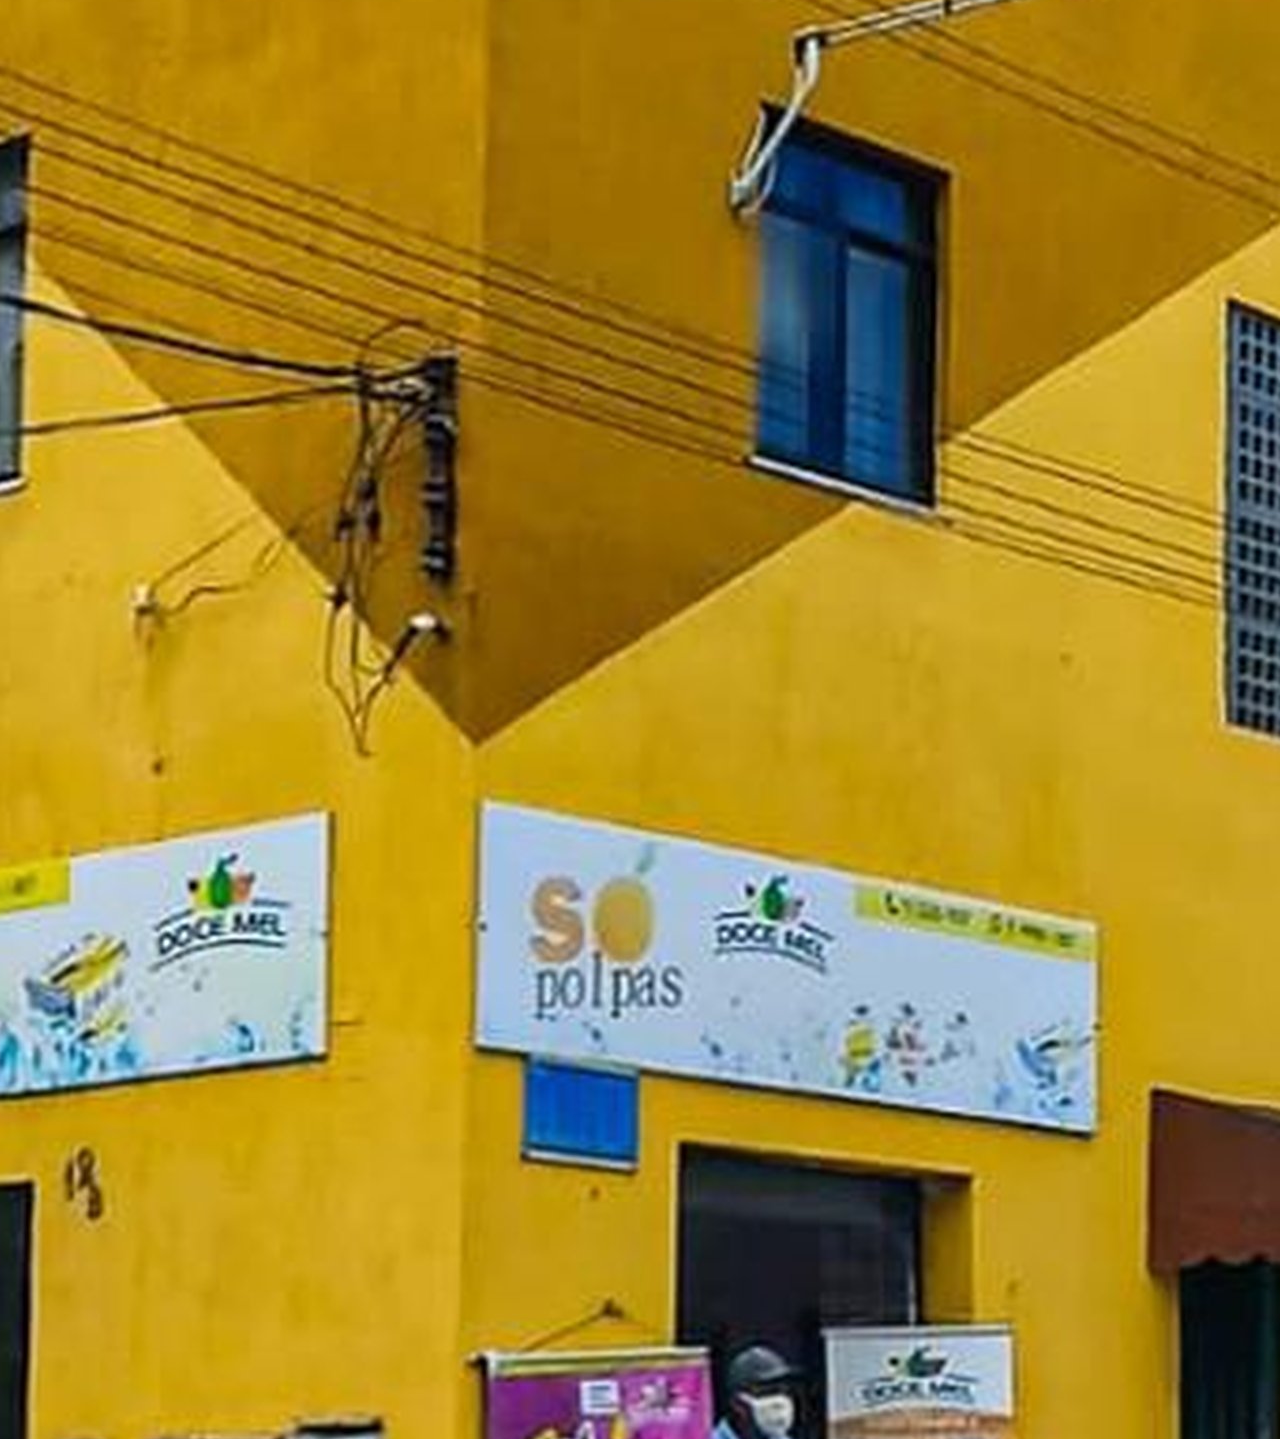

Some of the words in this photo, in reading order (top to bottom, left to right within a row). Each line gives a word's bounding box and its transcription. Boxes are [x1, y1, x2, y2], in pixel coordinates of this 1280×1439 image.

[157, 915, 228, 956] DOCE
[232, 912, 287, 937] MEL
[534, 950, 684, 1020] polpas
